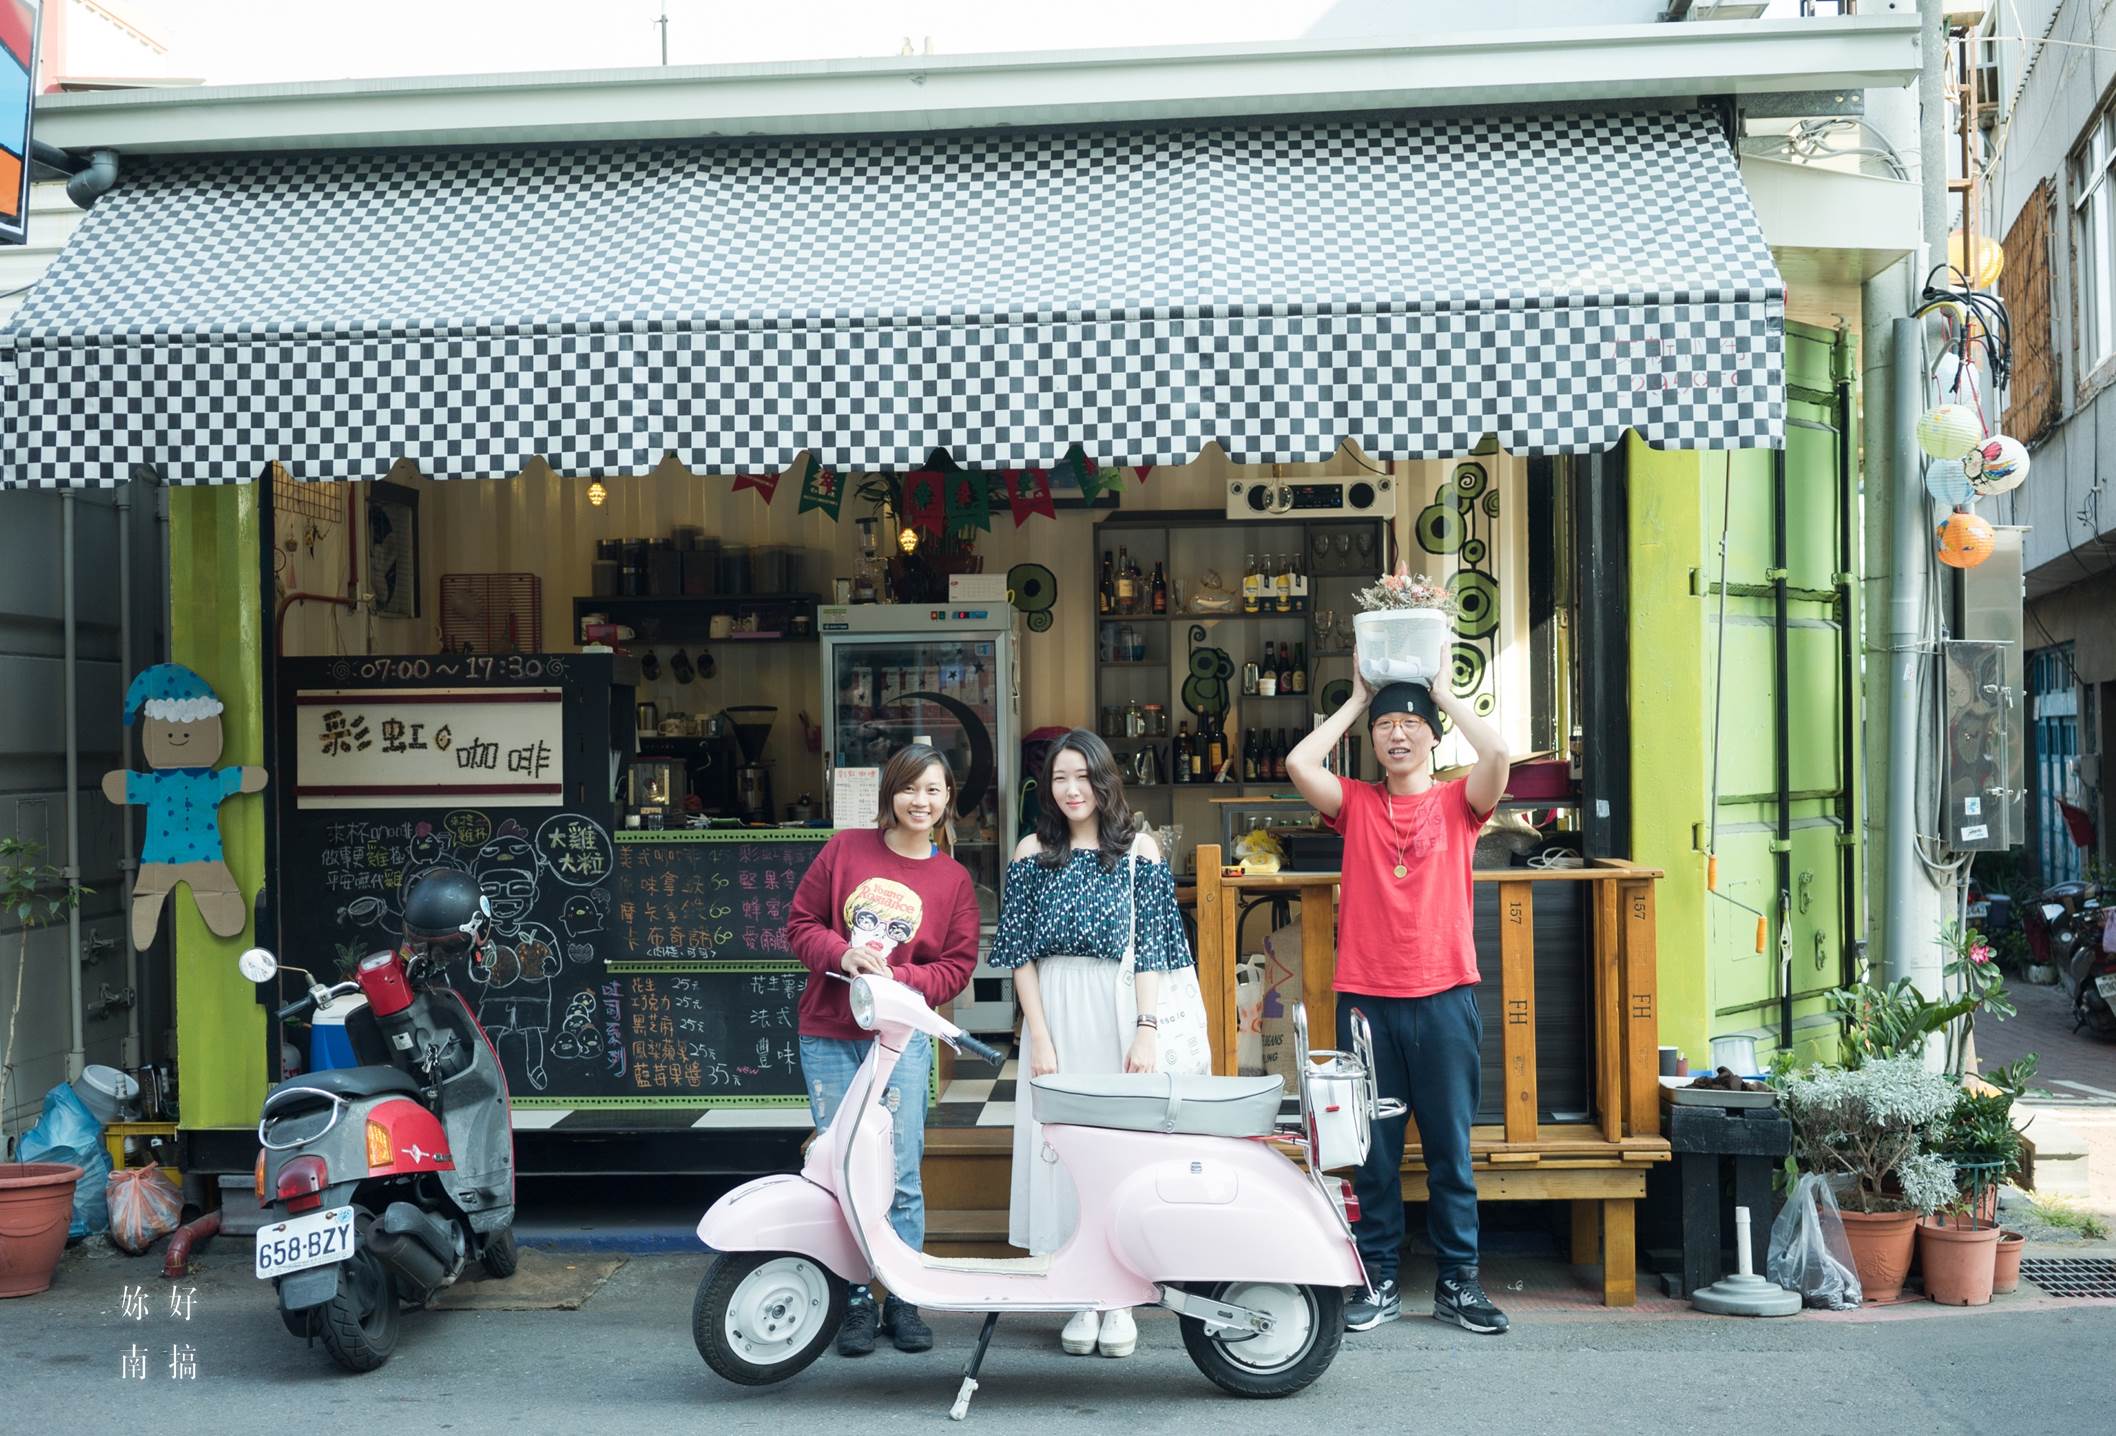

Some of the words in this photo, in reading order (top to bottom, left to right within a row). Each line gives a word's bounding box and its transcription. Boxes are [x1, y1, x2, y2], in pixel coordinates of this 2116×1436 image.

[318, 709, 428, 757] 彩虹
[457, 736, 552, 779] 咖啡
[1509, 901, 1522, 926] 157
[1633, 895, 1646, 921] 157
[630, 994, 671, 1012] 巧克力
[1508, 999, 1528, 1026] FH
[1632, 993, 1652, 1020] FH
